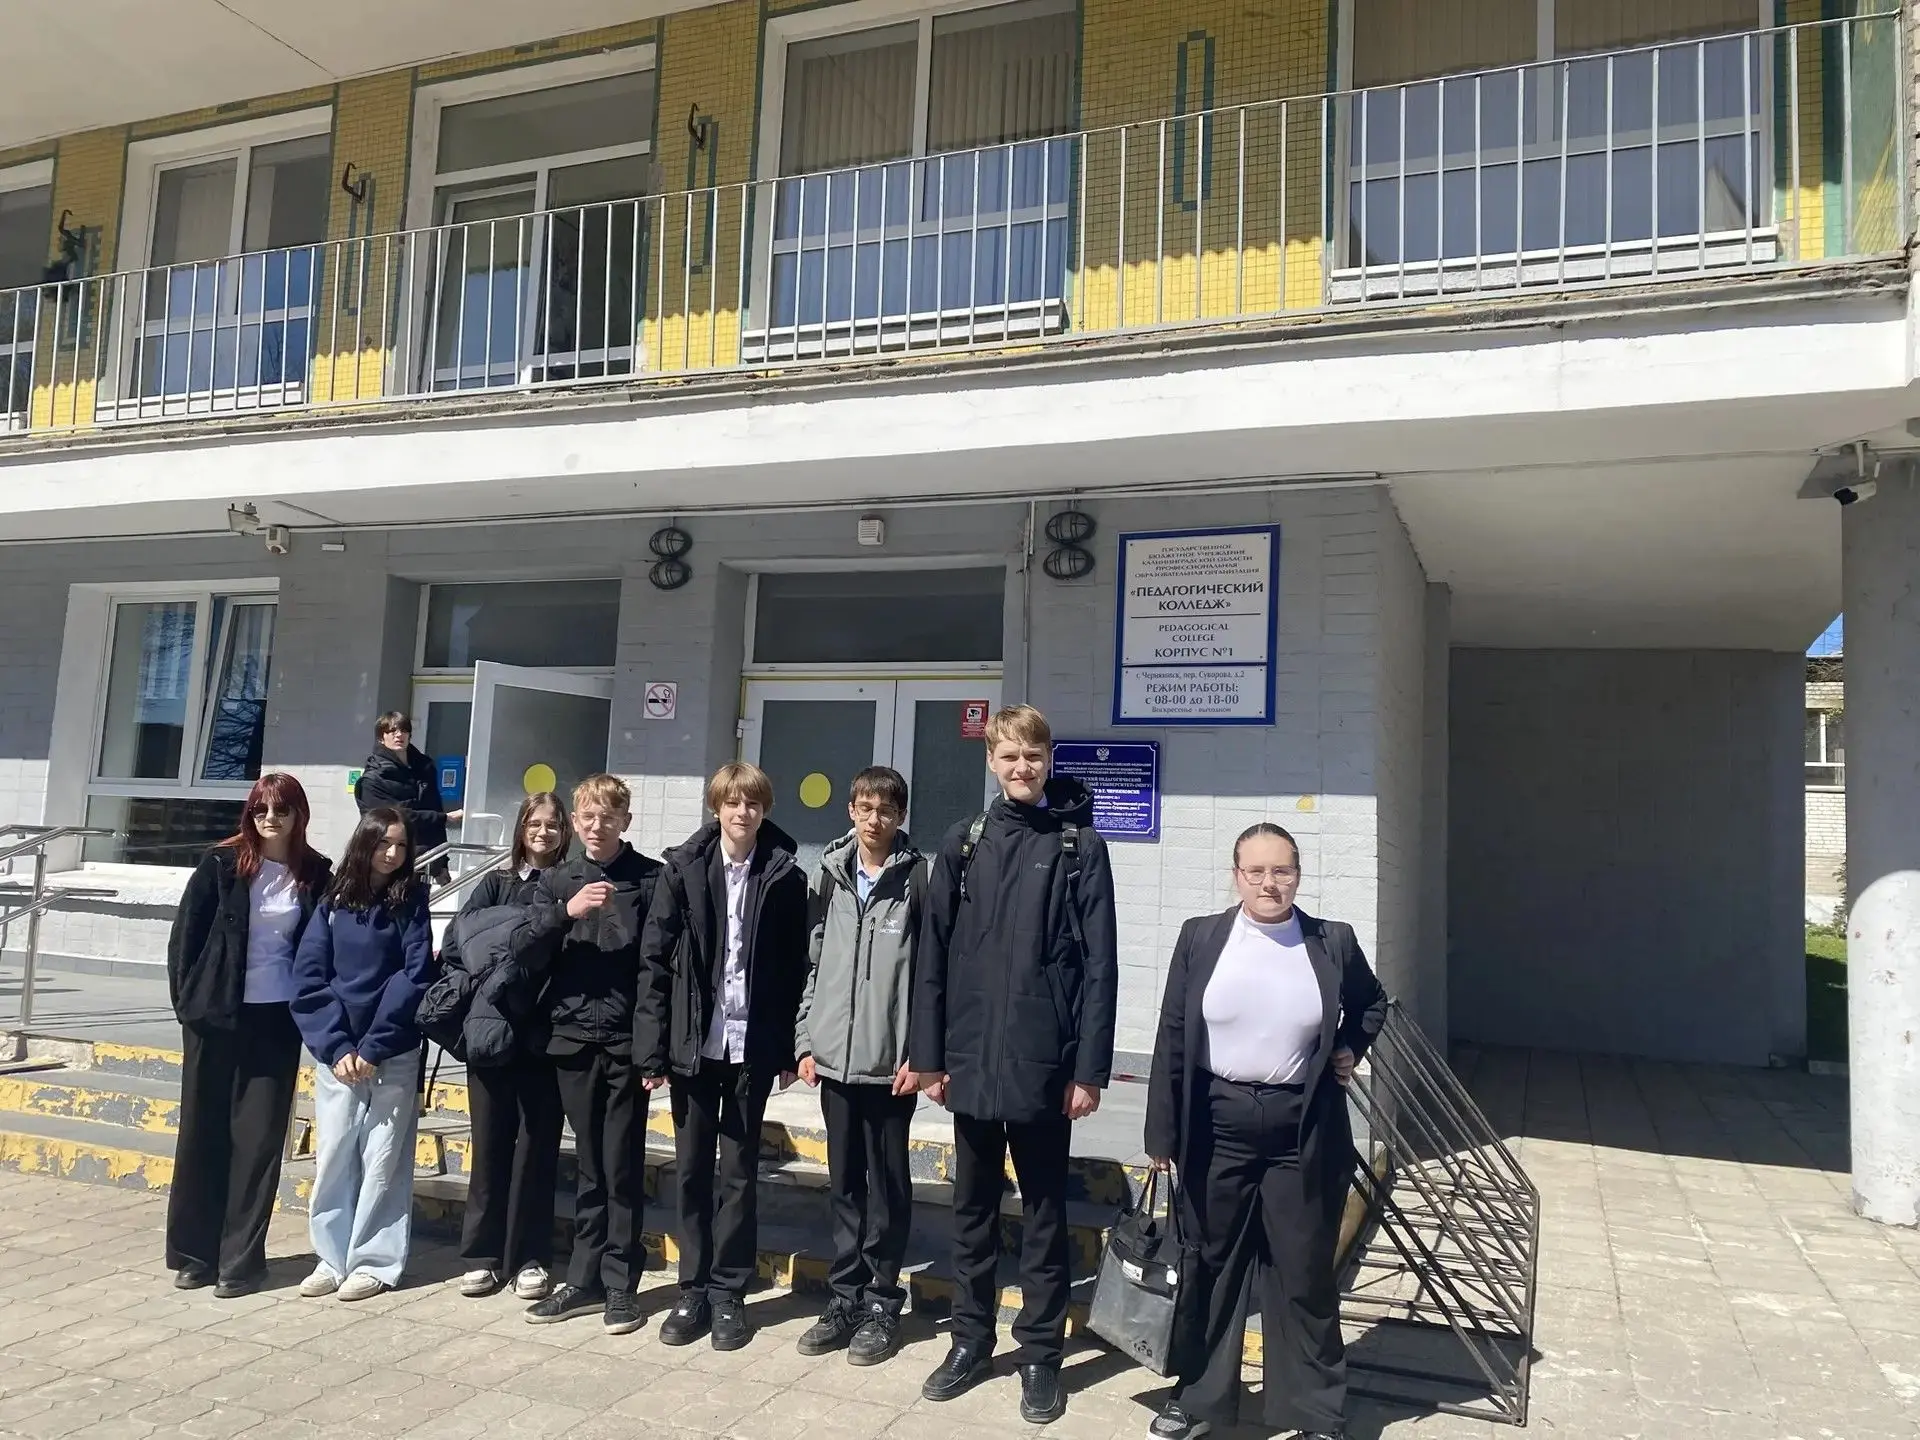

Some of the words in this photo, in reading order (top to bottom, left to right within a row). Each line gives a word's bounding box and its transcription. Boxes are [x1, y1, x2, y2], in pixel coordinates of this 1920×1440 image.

[1130, 581, 1264, 597] «ПЕДАГОГИЧЕСКИЙ
[1158, 599, 1231, 611] КОЛЛЕДЖ»
[1158, 623, 1230, 632] PEDAGOGICAL
[1172, 634, 1215, 642] COLLEGE
[1155, 647, 1208, 658] КОРПУС
[1146, 683, 1187, 693] РЕЖИМ
[1190, 682, 1239, 693] РАБОТЫ:
[1154, 695, 1186, 705] 08-00
[1189, 697, 1203, 705] до
[1208, 694, 1239, 705] 18-00
